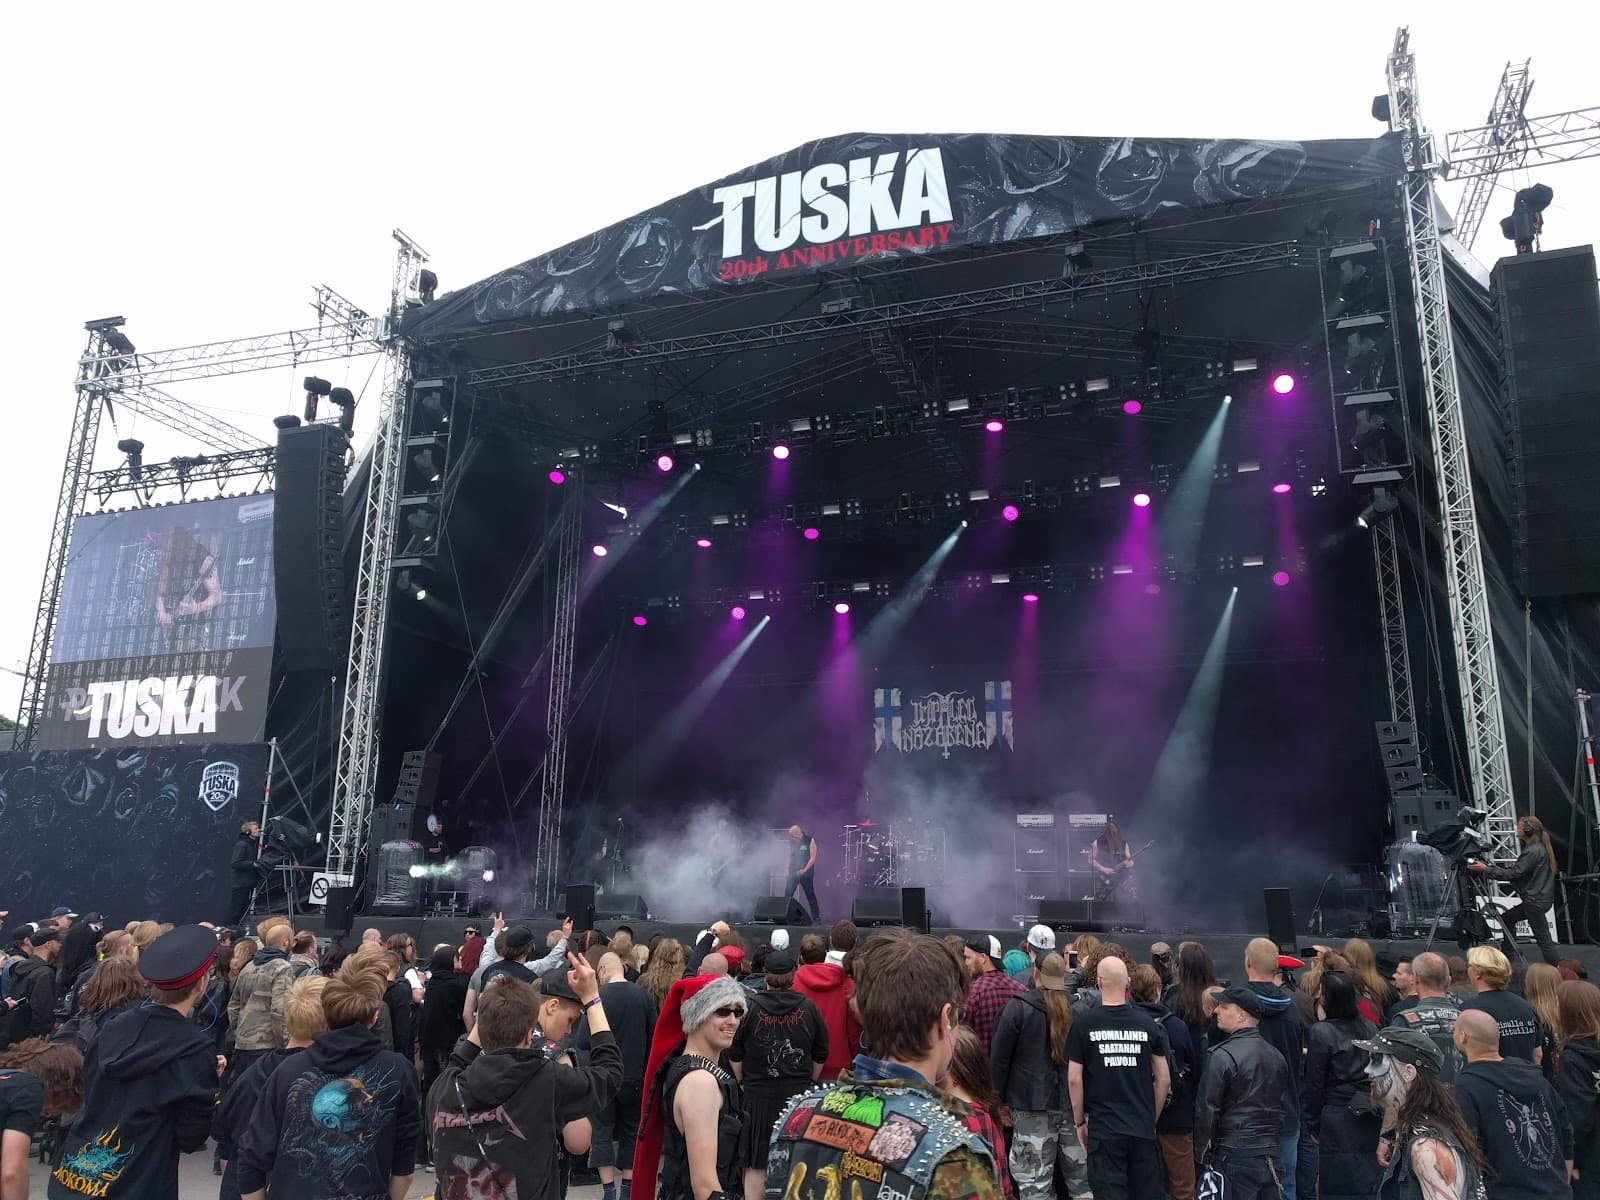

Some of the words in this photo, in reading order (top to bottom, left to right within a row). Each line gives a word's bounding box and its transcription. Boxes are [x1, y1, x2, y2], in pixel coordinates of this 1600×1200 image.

[694, 147, 953, 259] TUSKA
[720, 255, 768, 281] 20th
[775, 223, 954, 270] ANNIVERSARY
[76, 674, 217, 739] TUSKA
[203, 774, 236, 796] TUSKA
[1089, 1030, 1148, 1041] SUOMALAINEN
[1098, 1043, 1141, 1054] SAATANAN
[1104, 1056, 1137, 1067] PALVOJA
